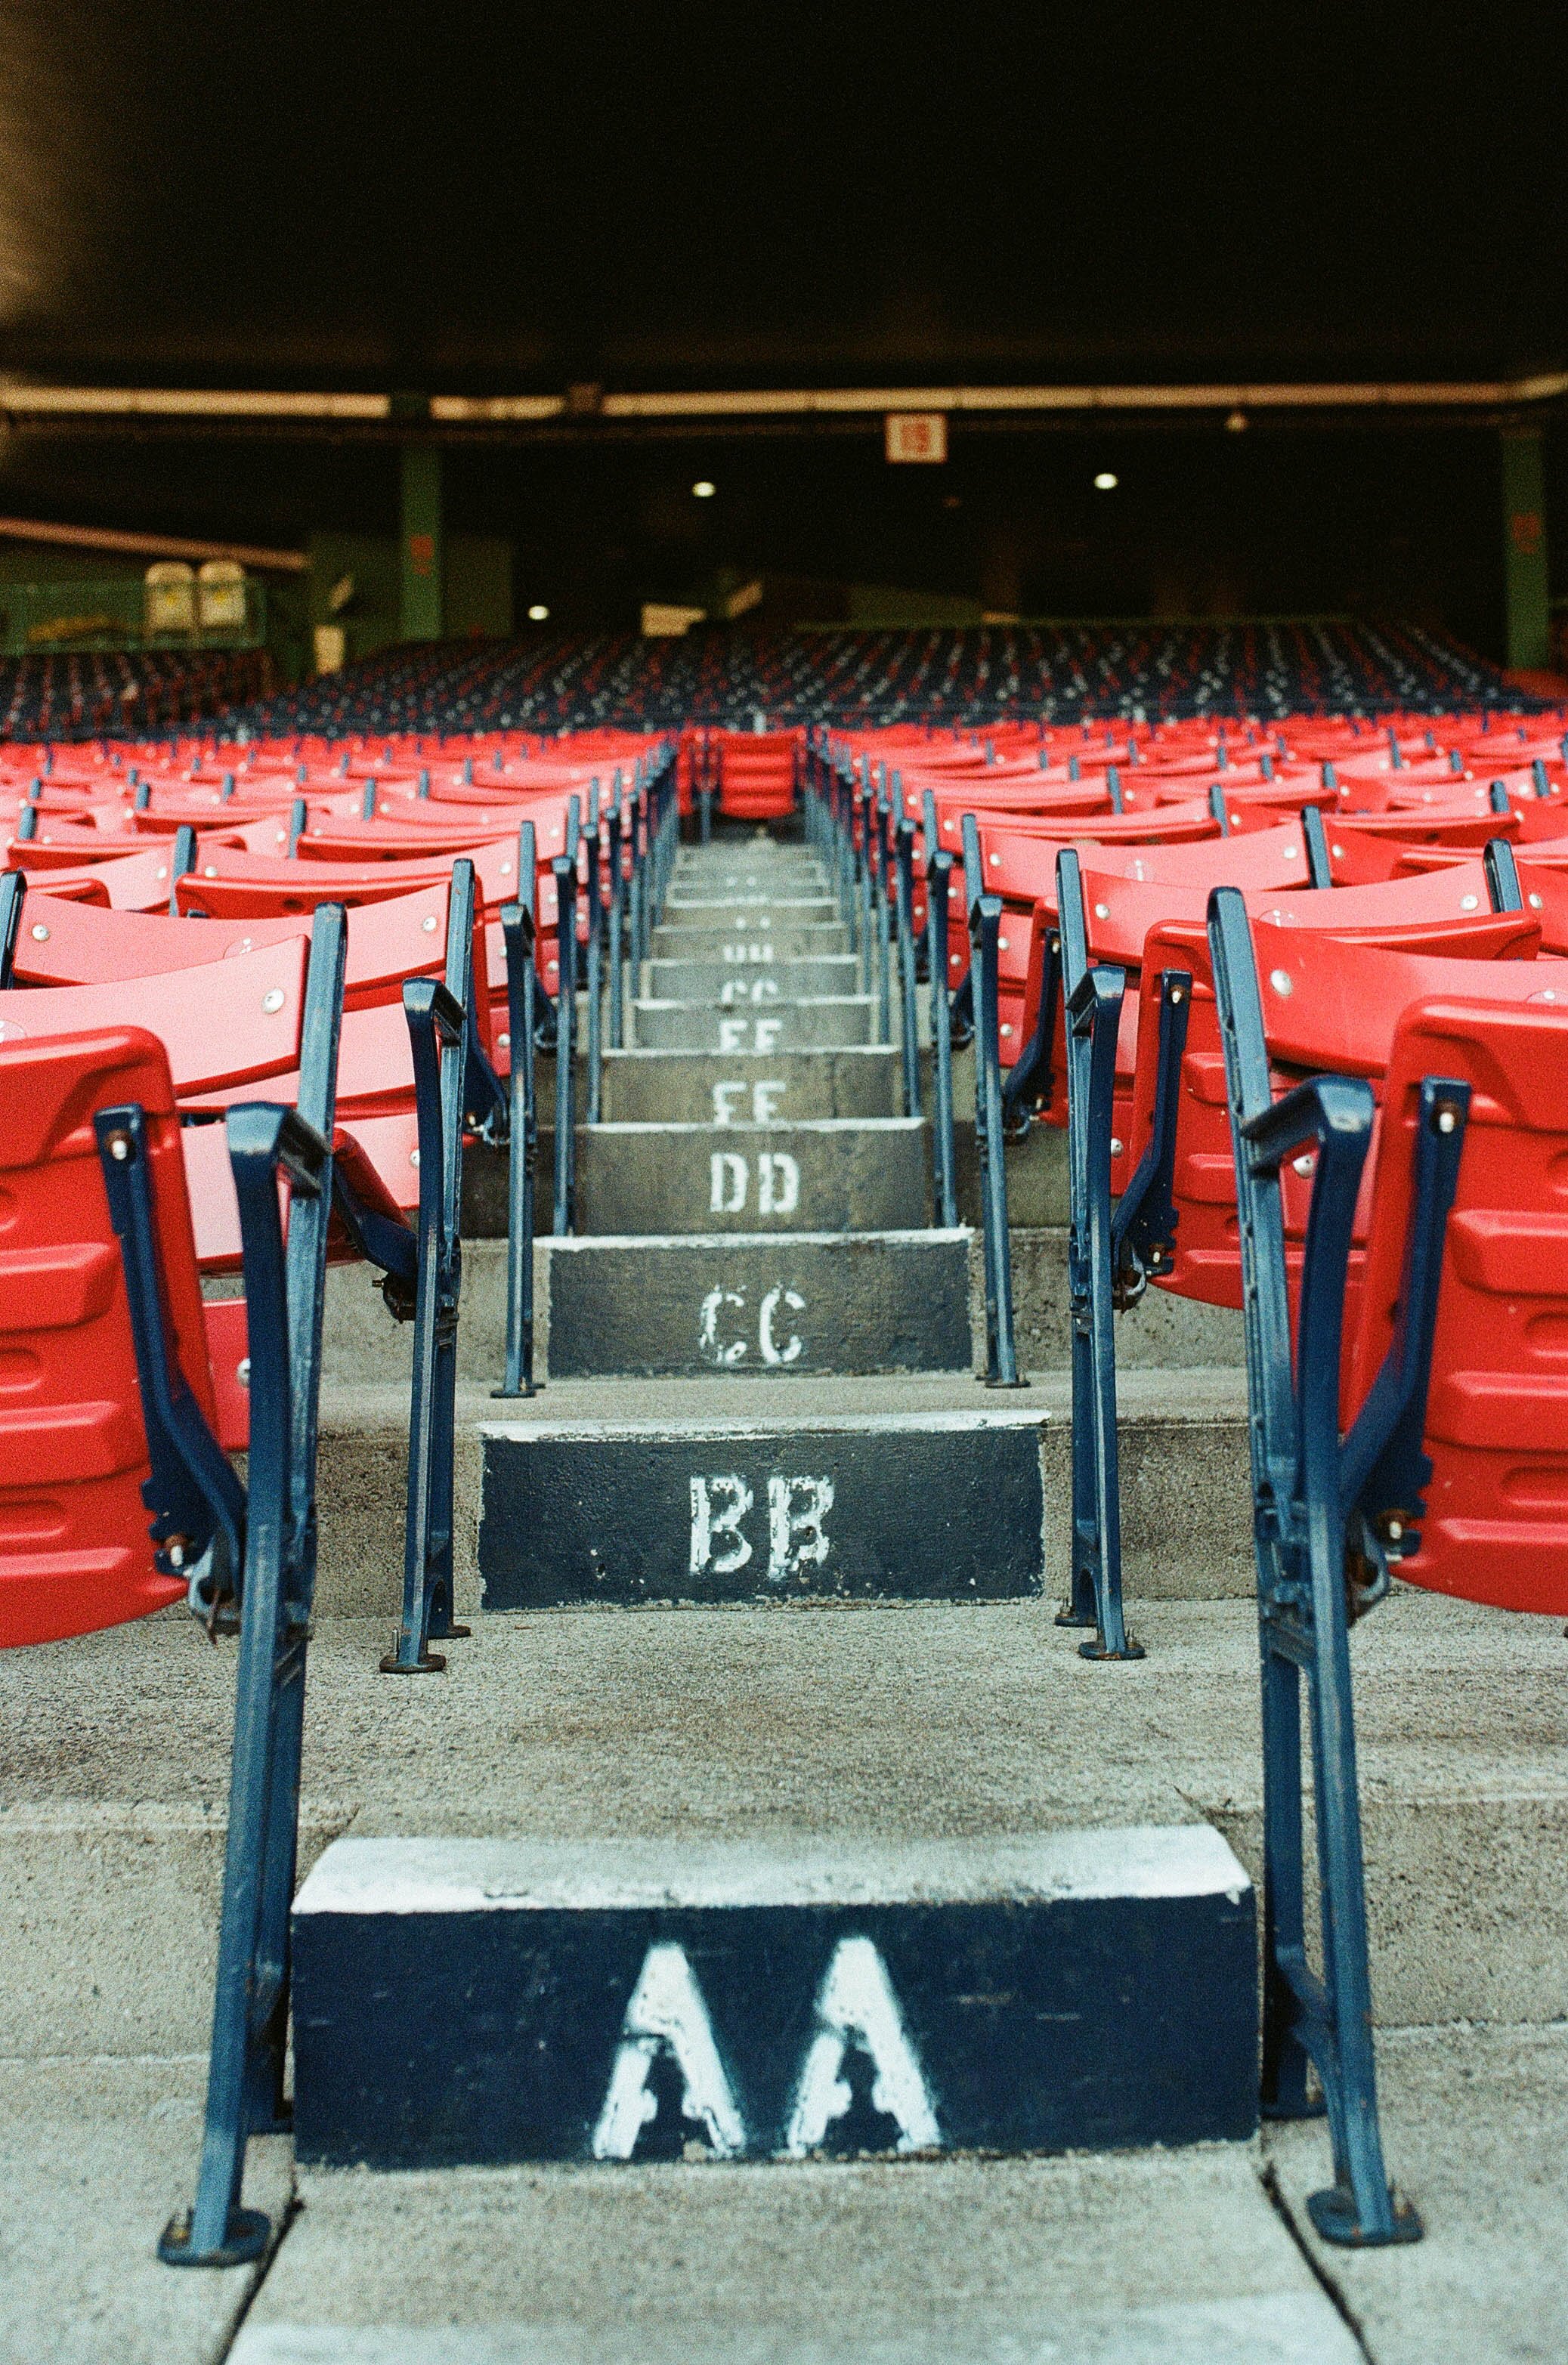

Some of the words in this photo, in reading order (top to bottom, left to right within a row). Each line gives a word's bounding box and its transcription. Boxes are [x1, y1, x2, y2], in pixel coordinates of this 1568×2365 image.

[709, 1152, 800, 1214] DD
[699, 1288, 806, 1363] CC
[689, 1473, 833, 1580] BB
[592, 1936, 942, 2159] AA
